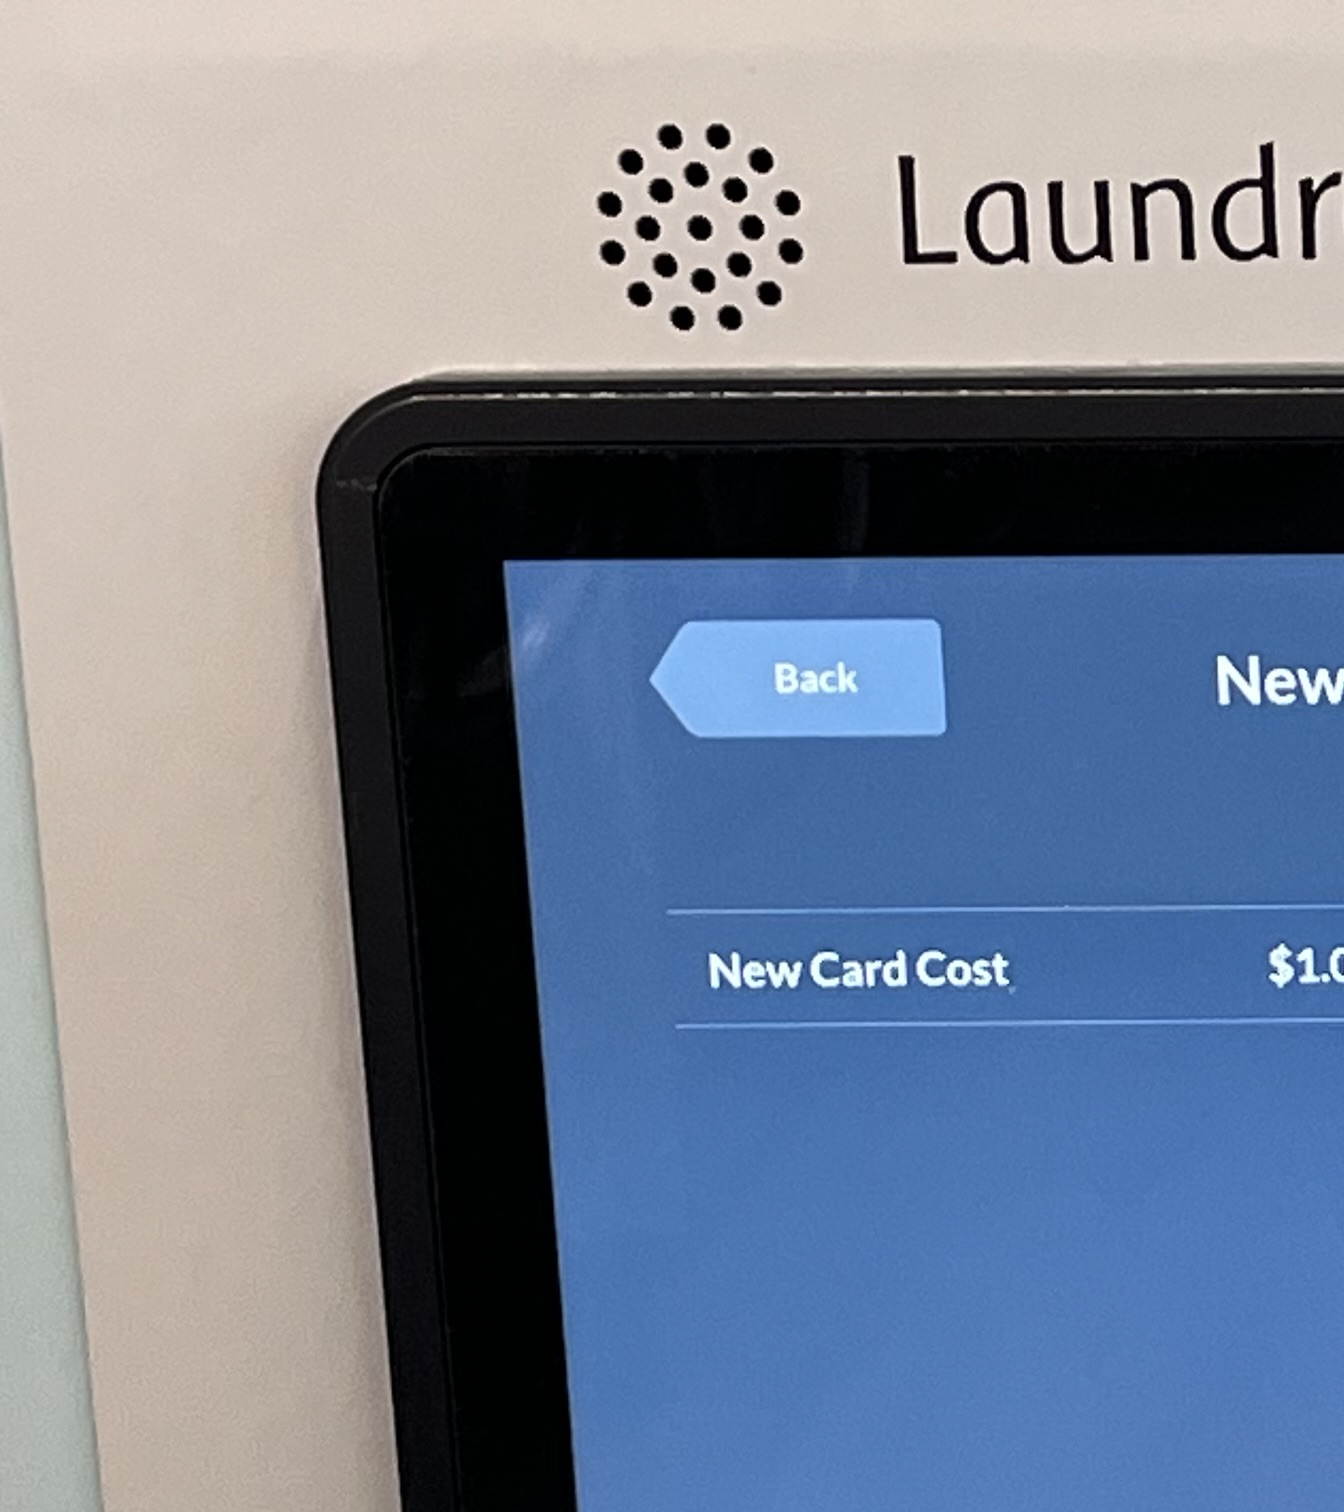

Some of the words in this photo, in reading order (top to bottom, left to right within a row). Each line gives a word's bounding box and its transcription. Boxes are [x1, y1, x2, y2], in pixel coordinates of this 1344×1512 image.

[773, 660, 859, 695] Back
[707, 950, 803, 989] New
[809, 948, 909, 989] Card
[915, 949, 1010, 988] Cost
